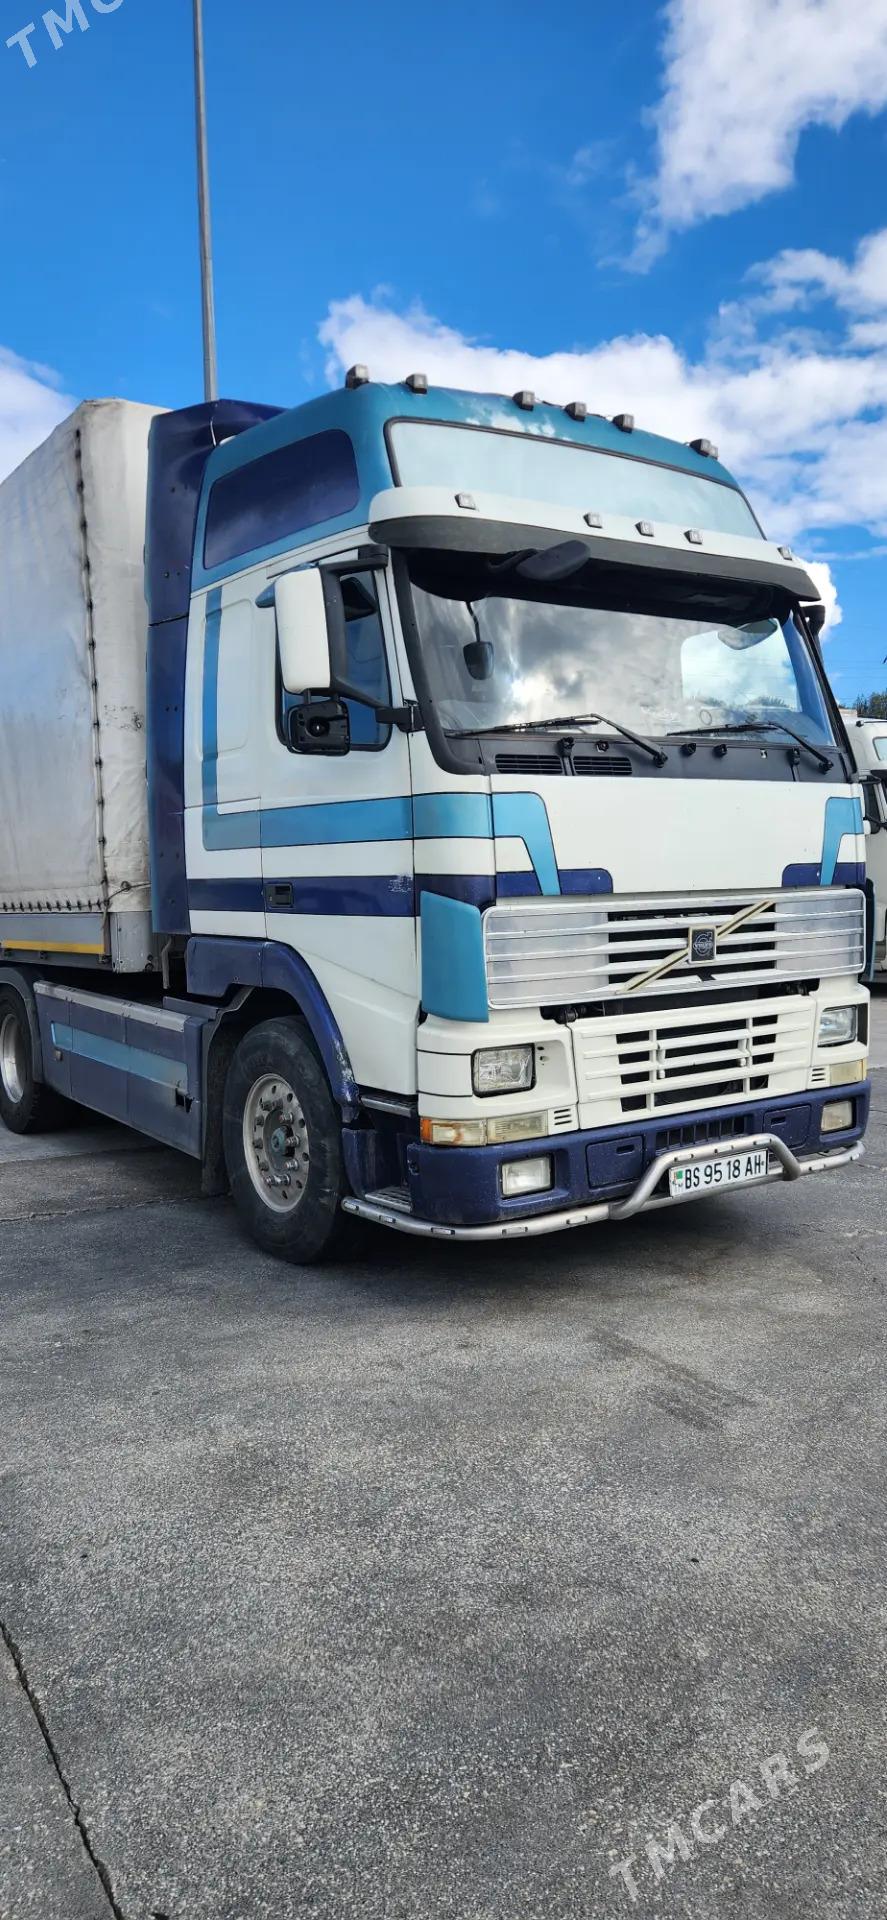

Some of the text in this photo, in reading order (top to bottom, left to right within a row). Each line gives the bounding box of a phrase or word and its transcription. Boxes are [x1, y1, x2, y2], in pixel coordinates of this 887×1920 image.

[685, 1167, 700, 1189] BS
[704, 1162, 723, 1184] 95
[727, 1159, 741, 1180] 18
[745, 1155, 761, 1176] AH
